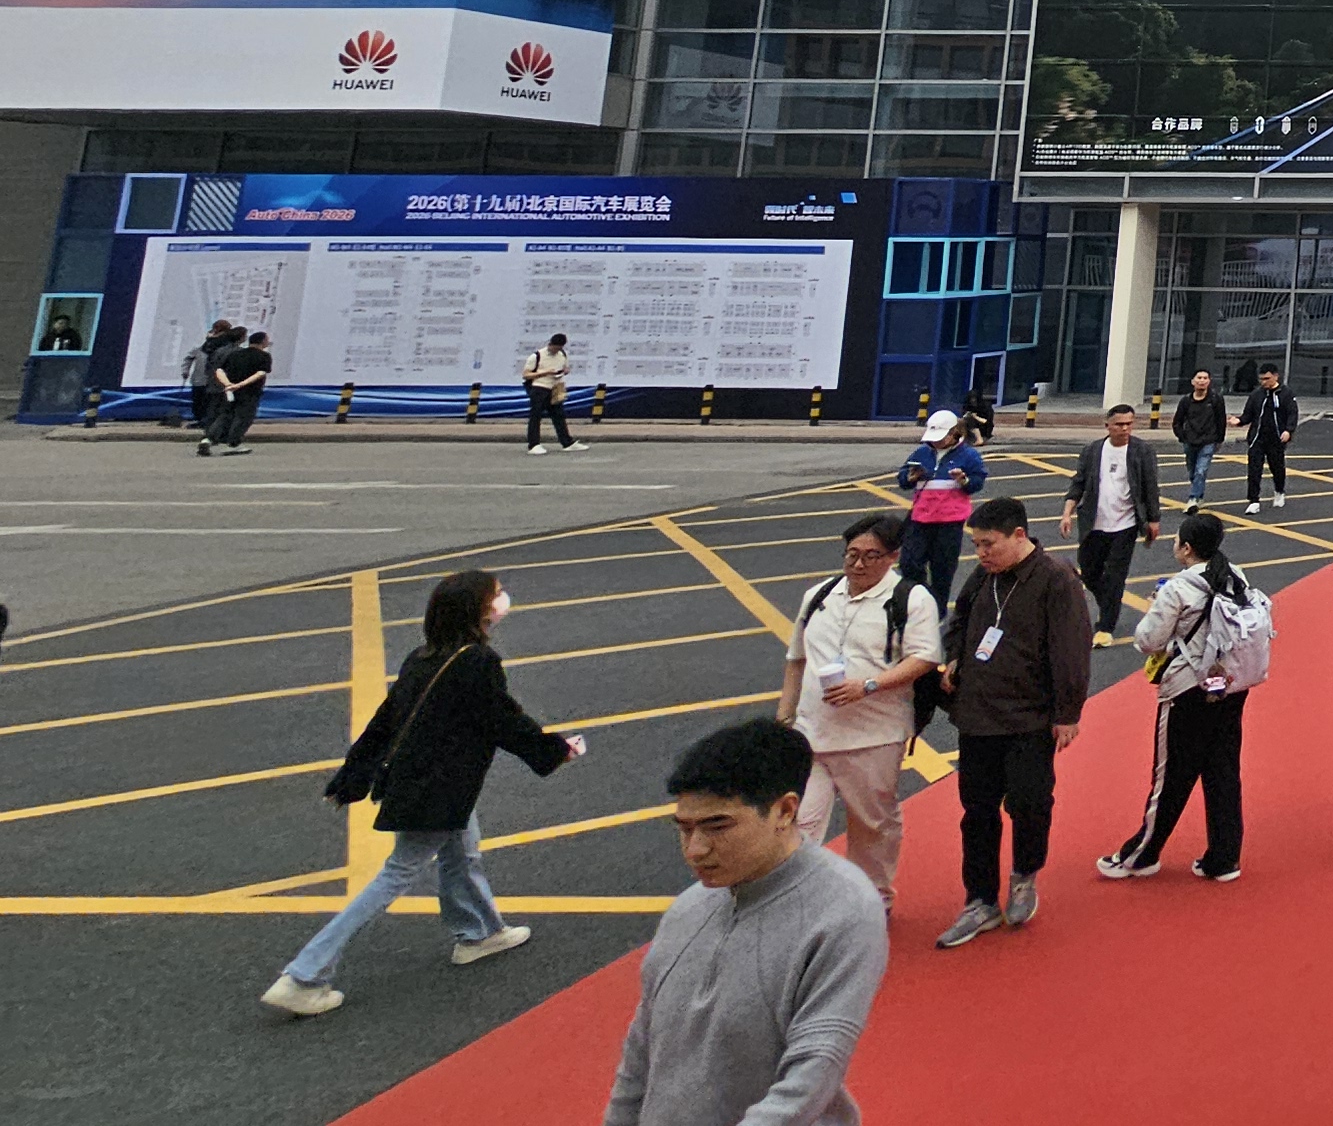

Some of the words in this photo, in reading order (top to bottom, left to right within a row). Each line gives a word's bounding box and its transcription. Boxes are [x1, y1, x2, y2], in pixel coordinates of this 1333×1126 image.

[332, 78, 394, 91] HUAWEI
[500, 85, 551, 102] HUAWEI
[245, 209, 281, 221] Auto
[281, 208, 319, 221] China
[320, 209, 356, 221] 2026
[471, 213, 550, 221] INTERNATIONAL
[551, 213, 614, 221] AUTOMOTIVE
[615, 213, 671, 222] EXHIBITION
